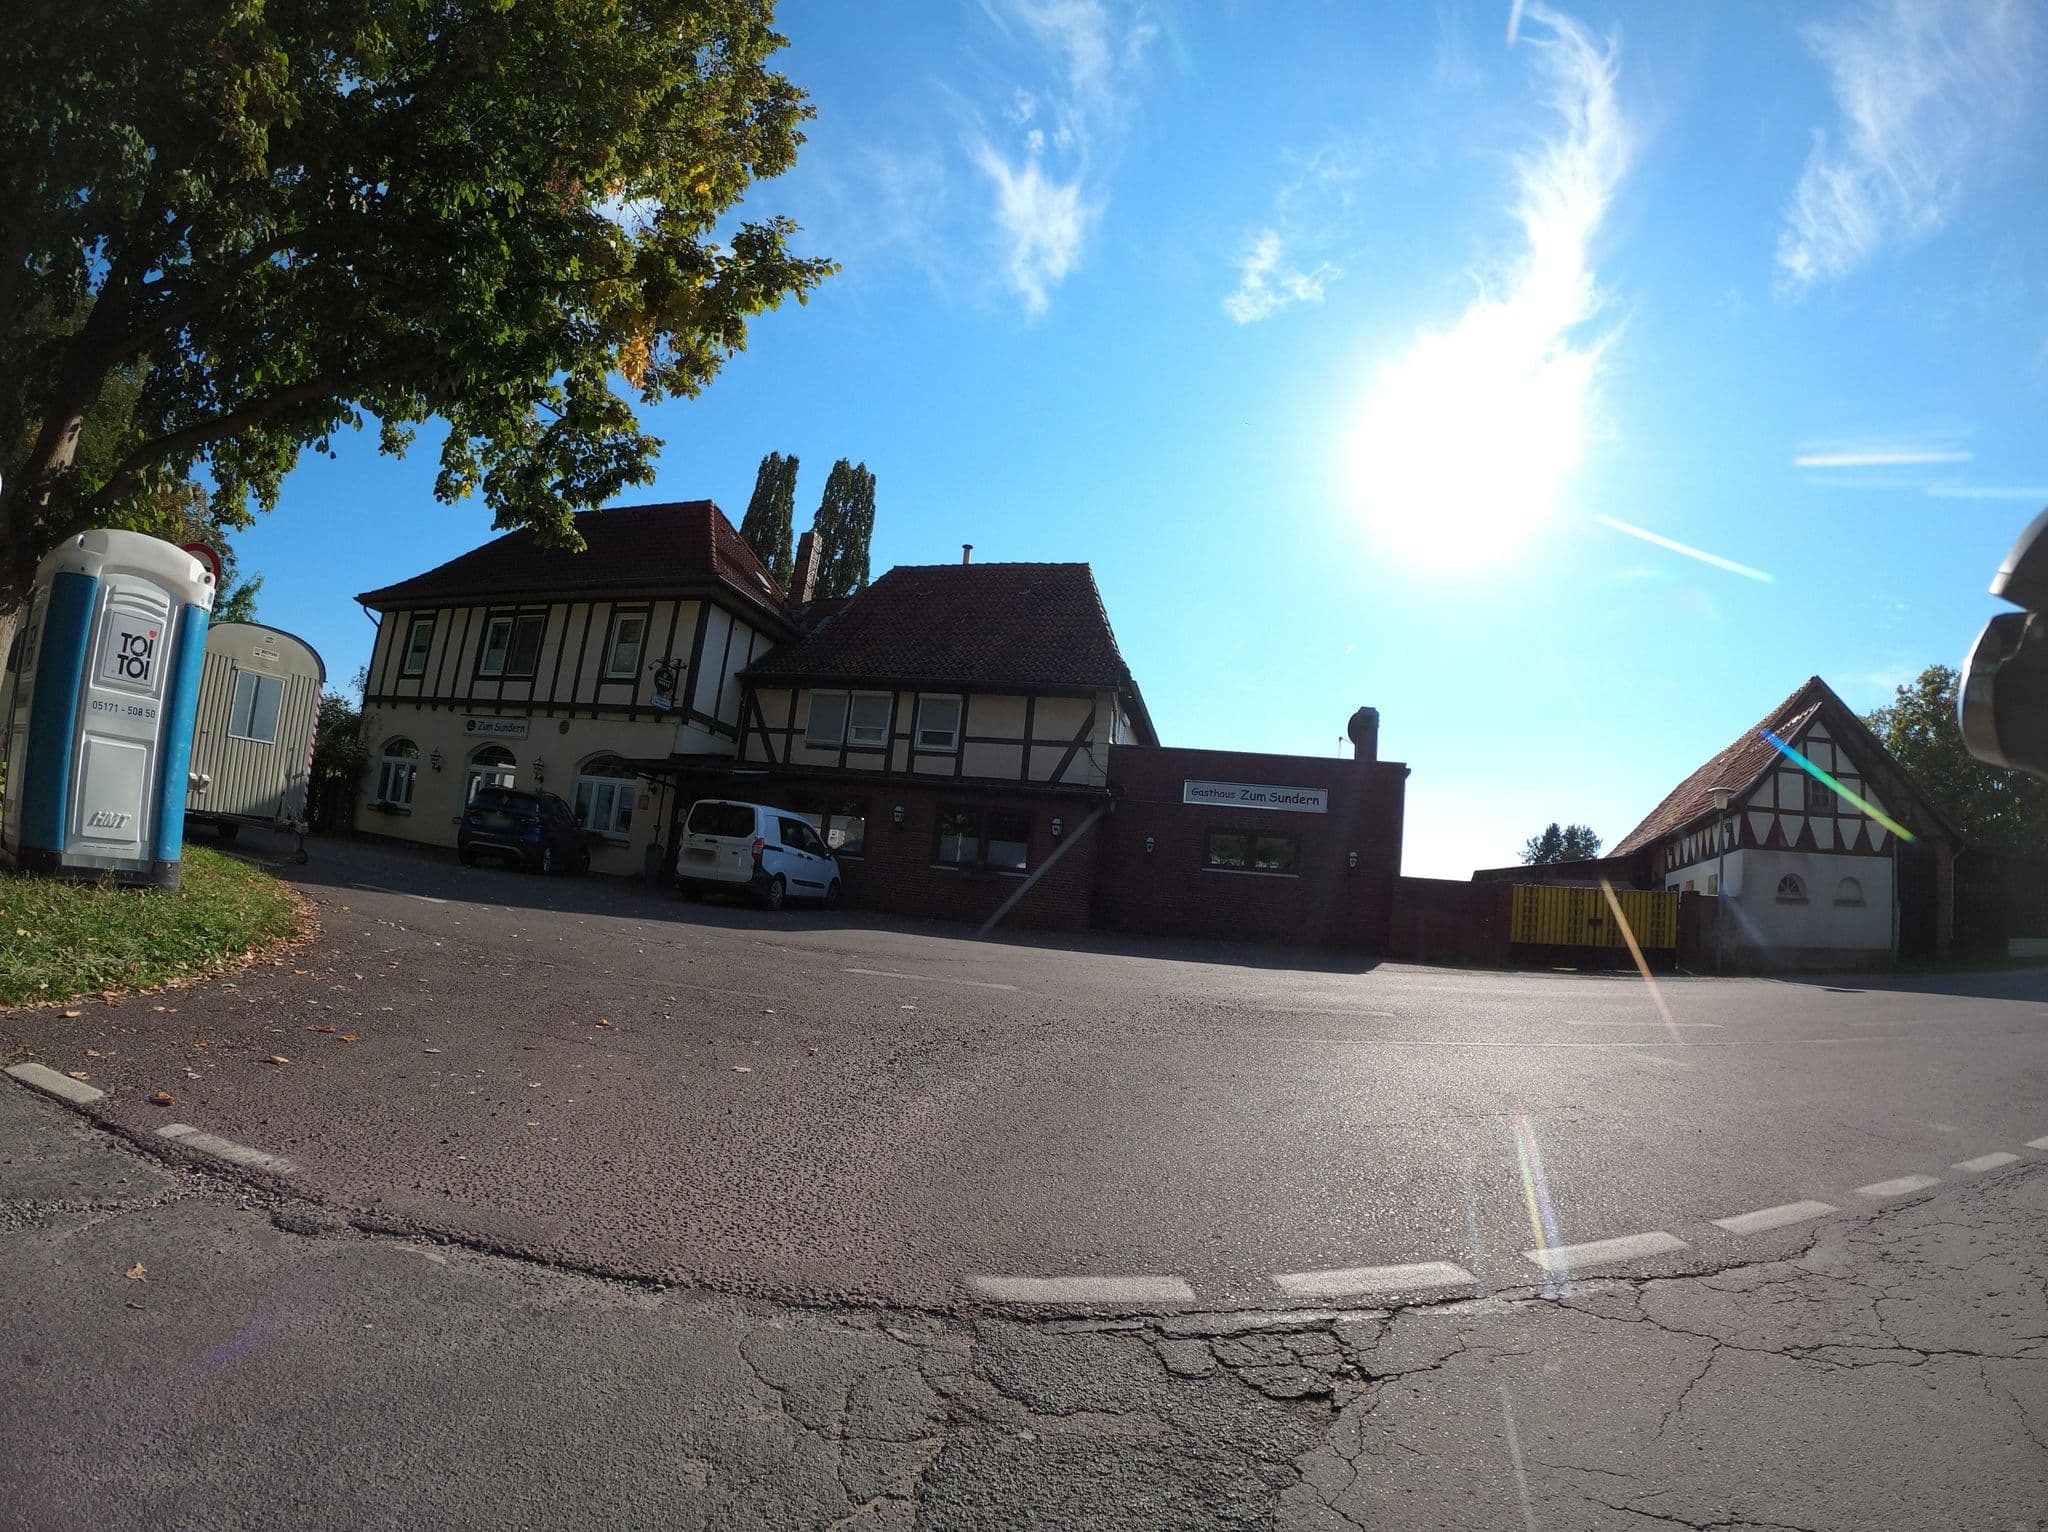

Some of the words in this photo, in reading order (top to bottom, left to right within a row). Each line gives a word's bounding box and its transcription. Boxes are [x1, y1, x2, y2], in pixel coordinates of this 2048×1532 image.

[117, 653, 151, 681] TOI
[92, 700, 118, 713] 05171
[127, 706, 143, 717] 508
[145, 709, 156, 719] 50
[478, 721, 493, 732] Zum
[494, 722, 525, 733] Sundern
[1191, 787, 1236, 799] Gasthaus
[1240, 789, 1266, 802] Zum
[1269, 792, 1320, 806] Sundern
